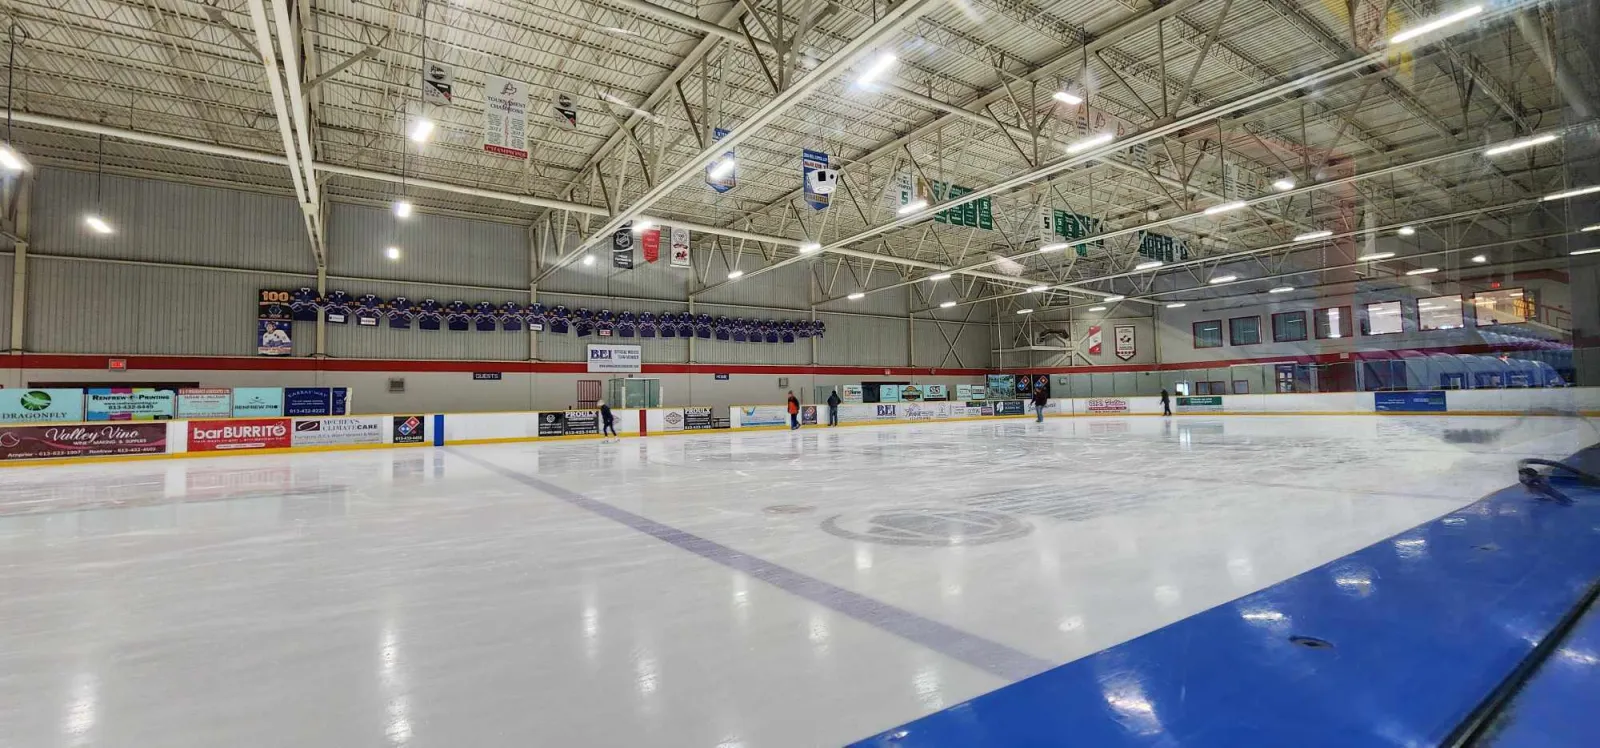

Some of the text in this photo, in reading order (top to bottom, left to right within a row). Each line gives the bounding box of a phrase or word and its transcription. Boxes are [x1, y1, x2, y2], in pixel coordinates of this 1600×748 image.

[262, 291, 290, 302] 100
[590, 349, 613, 360] BEI
[2, 412, 68, 420] DRAGONFLY
[877, 404, 897, 417] BEI
[45, 426, 140, 443] Valley Vino
[193, 423, 287, 440] barBURRITO
